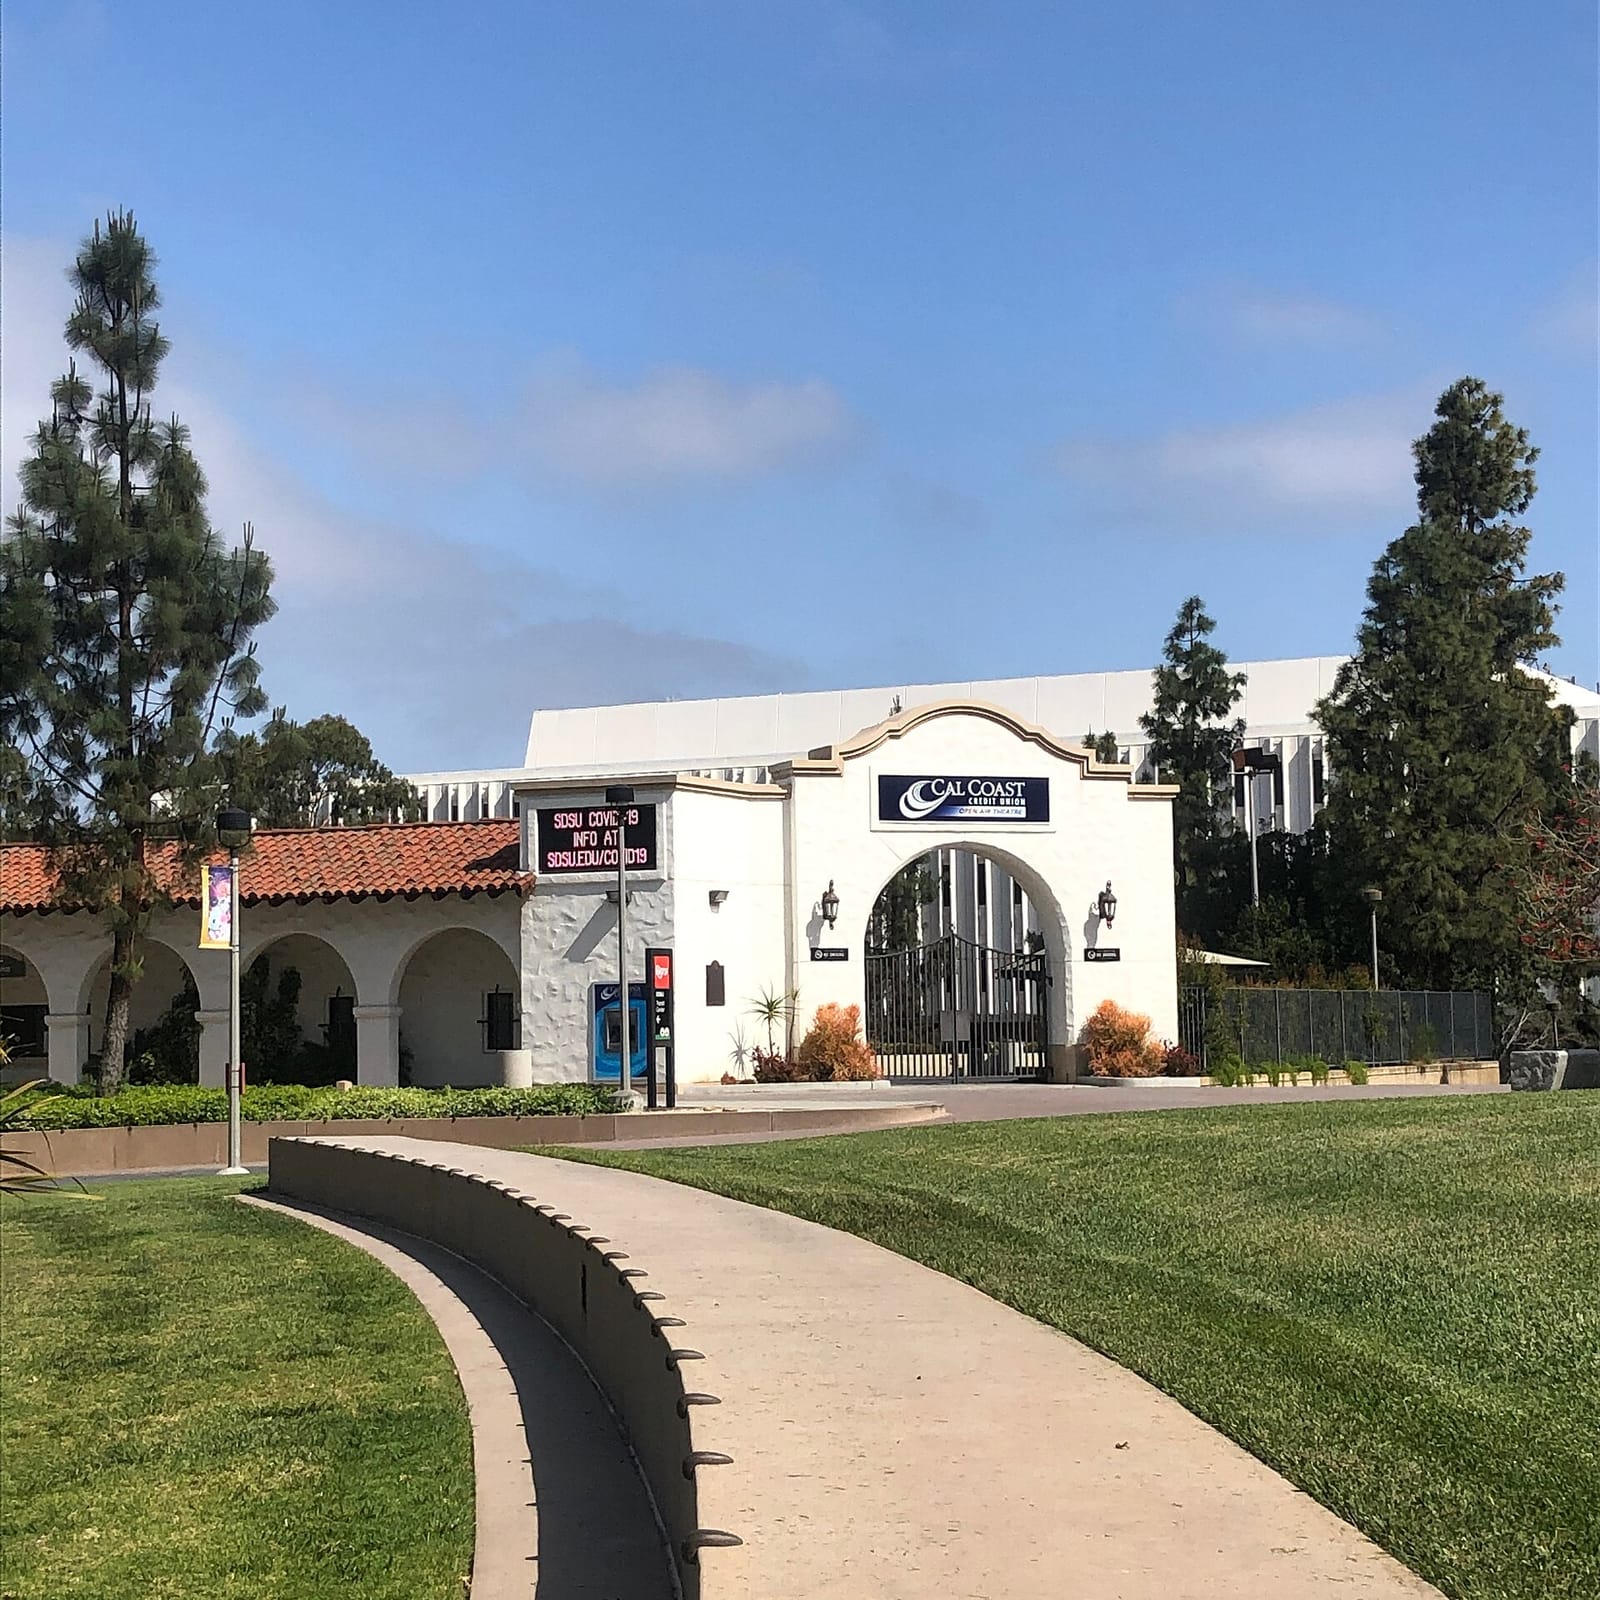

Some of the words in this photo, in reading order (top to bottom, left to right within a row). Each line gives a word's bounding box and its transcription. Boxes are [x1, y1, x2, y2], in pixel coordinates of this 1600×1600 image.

[967, 779, 1026, 797] COAST
[968, 797, 996, 805] CREDIT
[1000, 798, 1026, 806] UNION
[554, 813, 582, 829] SDSU
[573, 831, 597, 847] INFO
[603, 830, 618, 846] AT
[547, 848, 648, 868] SDSU.EDU/COID19
